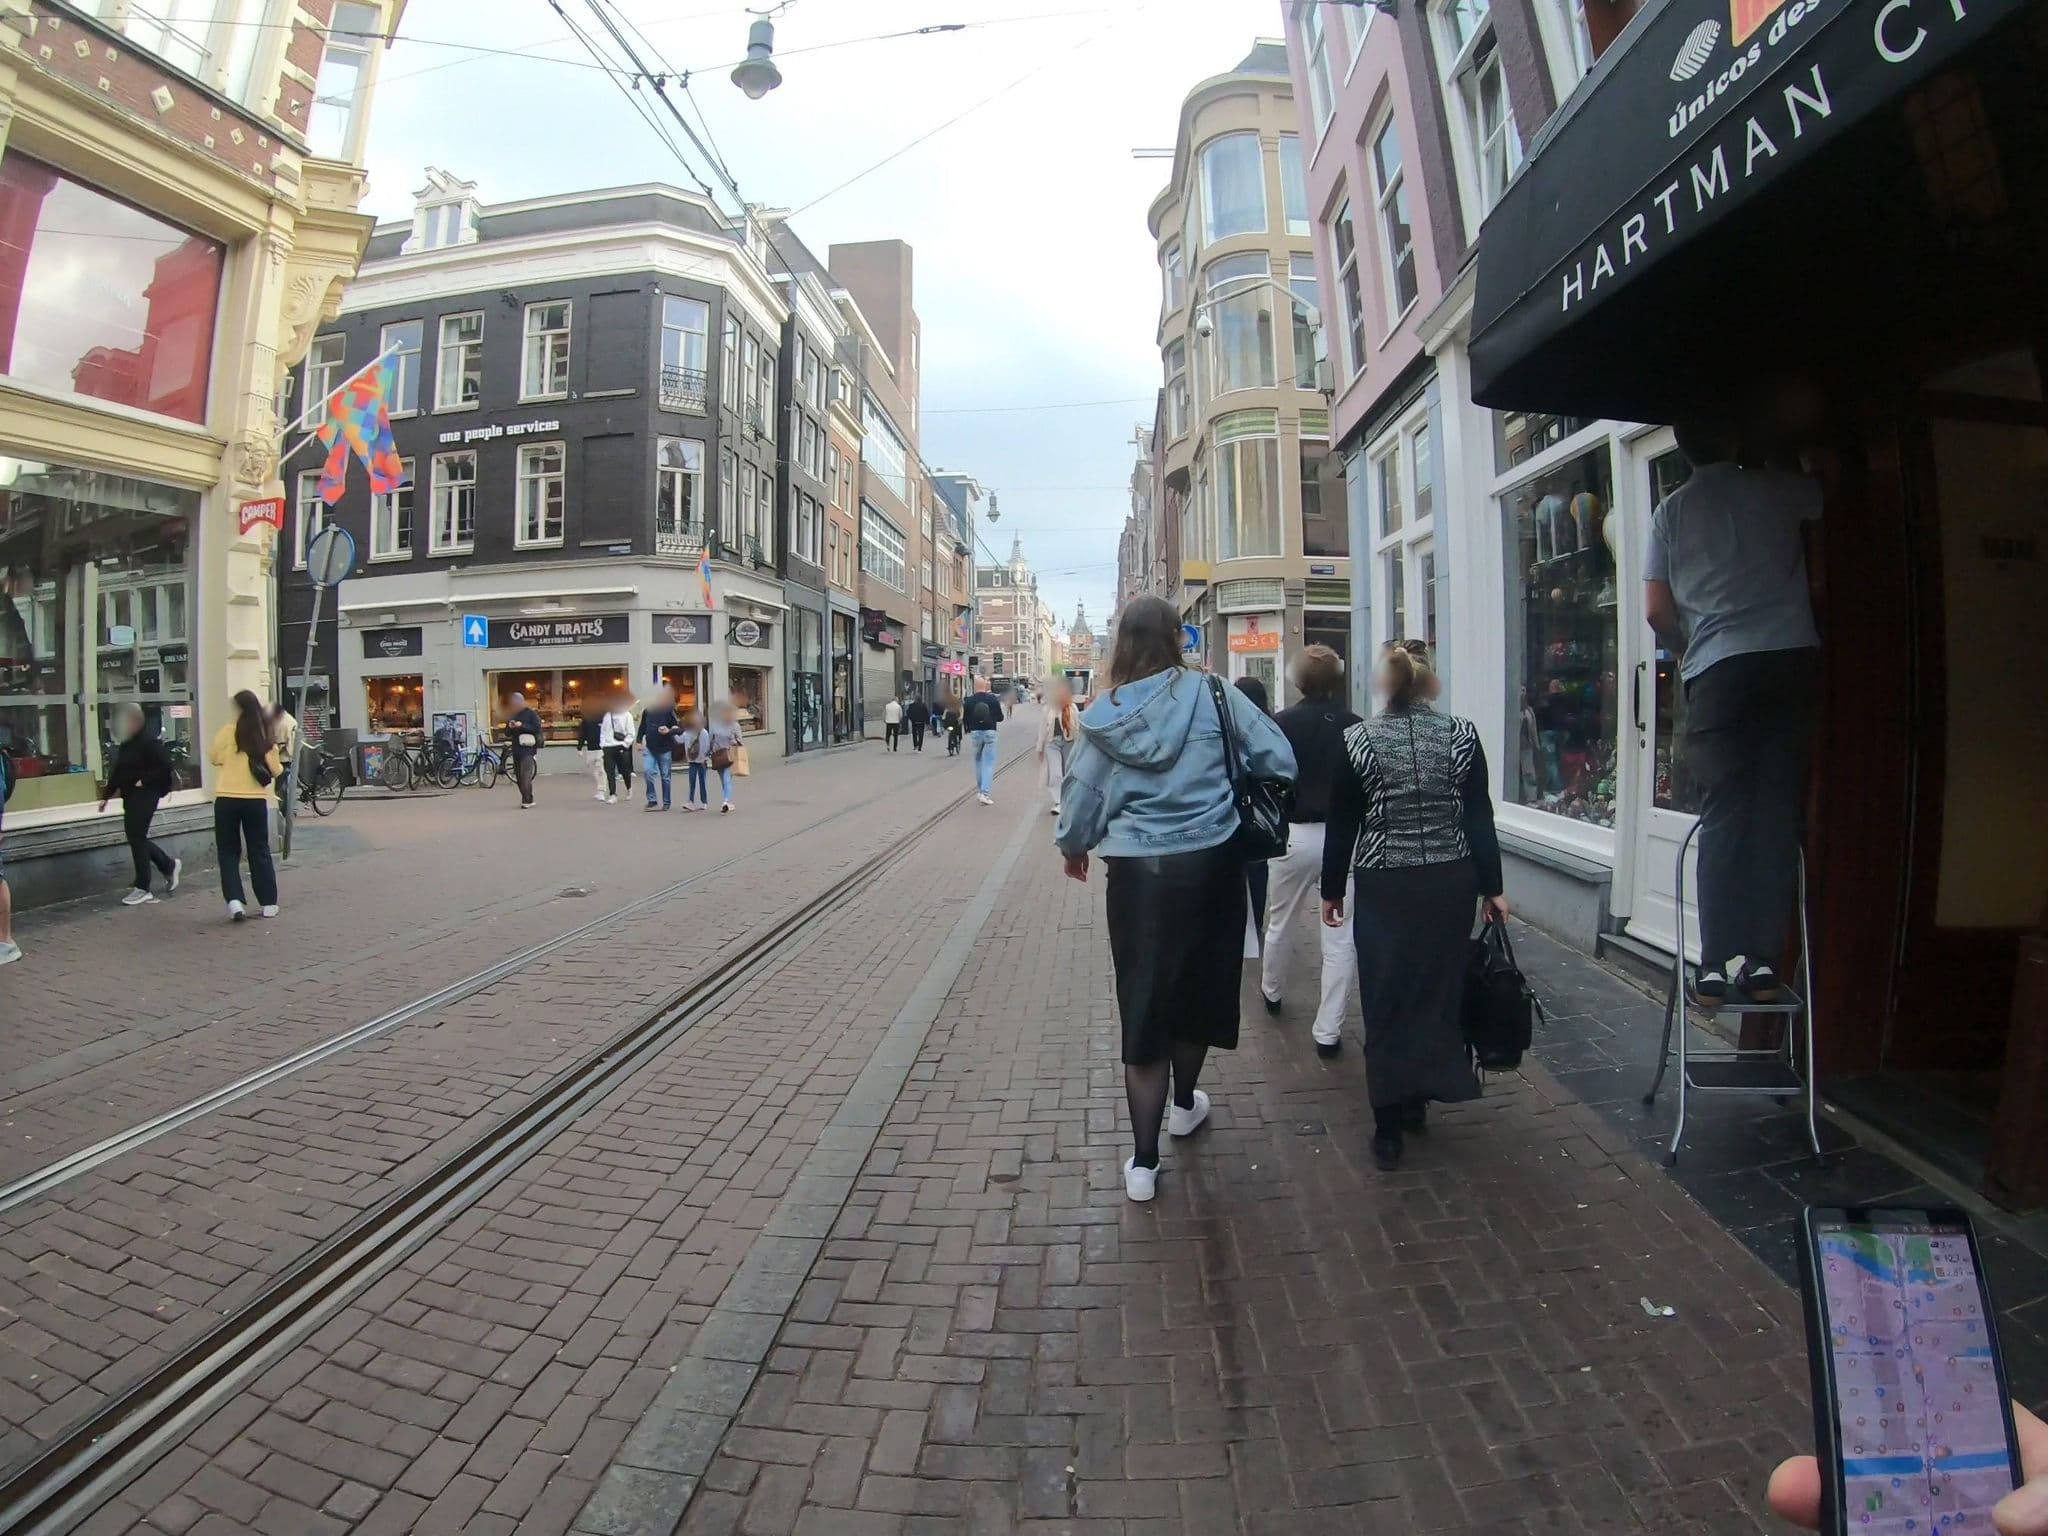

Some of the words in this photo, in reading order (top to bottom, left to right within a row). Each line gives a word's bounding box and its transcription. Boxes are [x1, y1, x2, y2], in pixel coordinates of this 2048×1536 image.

[1668, 42, 1762, 138] únicos
[1562, 63, 1832, 312] HARTMAN
[439, 431, 461, 443] one
[464, 424, 504, 443] people
[506, 420, 560, 435] services
[241, 502, 277, 525] CAMPER
[509, 622, 551, 640] CANDY
[555, 618, 604, 637] PIRATES
